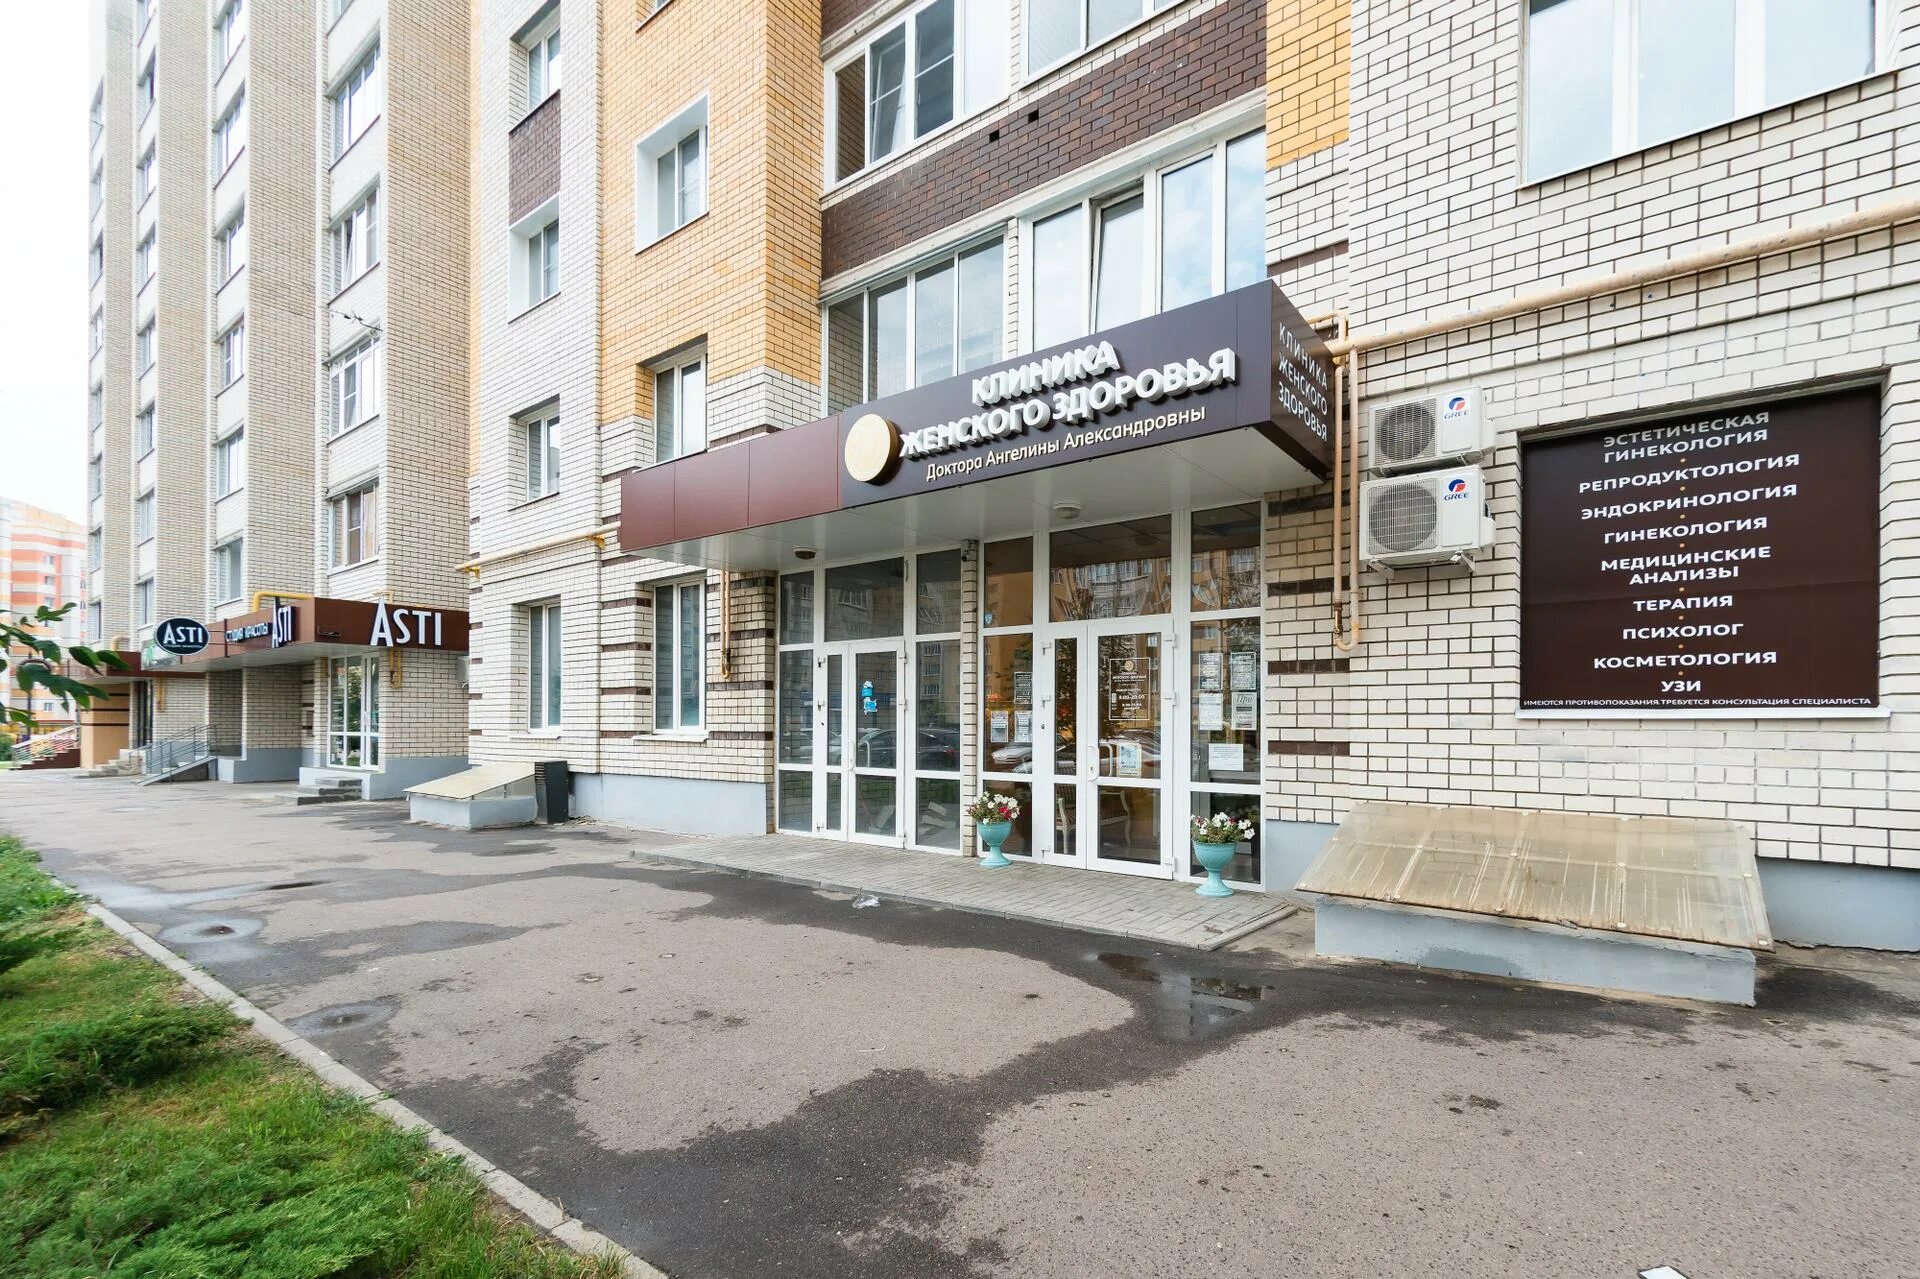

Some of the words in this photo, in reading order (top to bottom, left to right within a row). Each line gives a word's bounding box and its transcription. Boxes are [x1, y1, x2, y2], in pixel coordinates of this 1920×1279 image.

[1279, 321, 1328, 391] КЛИНИКА
[971, 340, 1121, 406] КЛИНИКА
[1278, 352, 1328, 416] ЖЕНСКОГО
[899, 398, 1051, 459] ЖЕНСКОГО
[1052, 347, 1236, 424] ЗДОРОВЬЯ
[1278, 381, 1328, 442] ЗДОРОВЬЯ
[1444, 410, 1470, 420] GREE
[926, 457, 983, 482] Доктора
[985, 439, 1060, 467] Ангелины
[1063, 405, 1206, 450] Александровны
[1603, 411, 1770, 448] ЭСТЕТИЧЕСКАЯ
[1603, 428, 1768, 464] ГИНЕКОЛОГИЯ
[1578, 453, 1800, 494] РЕПРОДУКТОЛОГИЯ
[1444, 491, 1470, 501] GREE
[1580, 484, 1798, 520] ЭНДОКРИНОЛОГИЯ
[1603, 516, 1768, 545] ГИНЕКОЛОГИЯ
[1601, 545, 1772, 572] МЕДИЦИНСКИЕ
[1629, 566, 1739, 586] АНАЛИЗЫ
[1633, 595, 1734, 612] ТЕРАПИЯ
[1622, 623, 1744, 640] ПСИХОЛОГ
[1593, 651, 1778, 670] КОСМЕТОЛОГИЯ
[1523, 699, 1564, 707] ИМЕЮТСЯ
[1712, 698, 1790, 707] КОНСУЛЬТАЦИЯ
[1792, 698, 1872, 706] СПЕЦИАЛИСТА
[1660, 680, 1701, 693] УЗИ
